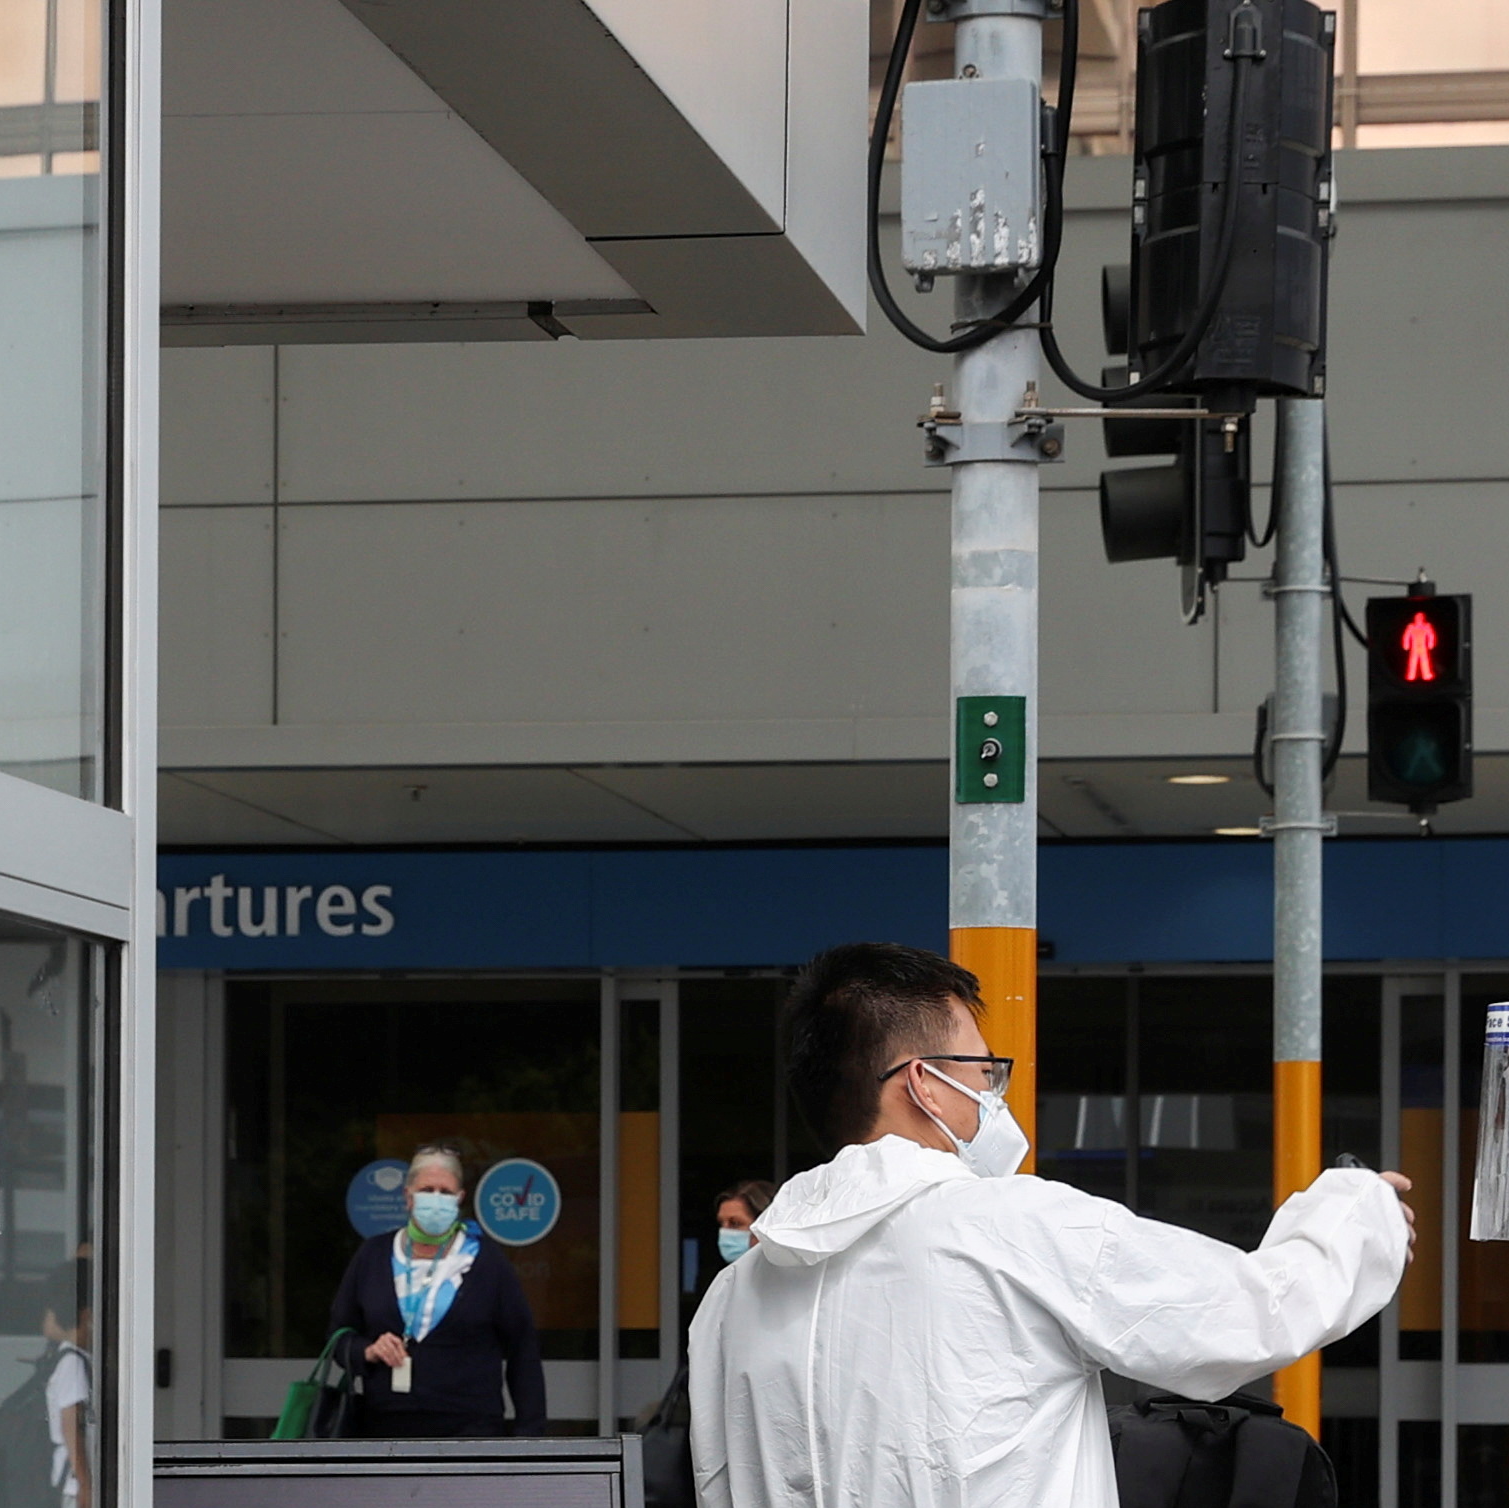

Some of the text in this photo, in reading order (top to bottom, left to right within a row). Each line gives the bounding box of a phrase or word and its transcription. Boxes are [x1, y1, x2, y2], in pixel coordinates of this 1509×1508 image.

[156, 874, 395, 937] rtures
[489, 1192, 546, 1206] COVID
[494, 1208, 541, 1221] SAFE
